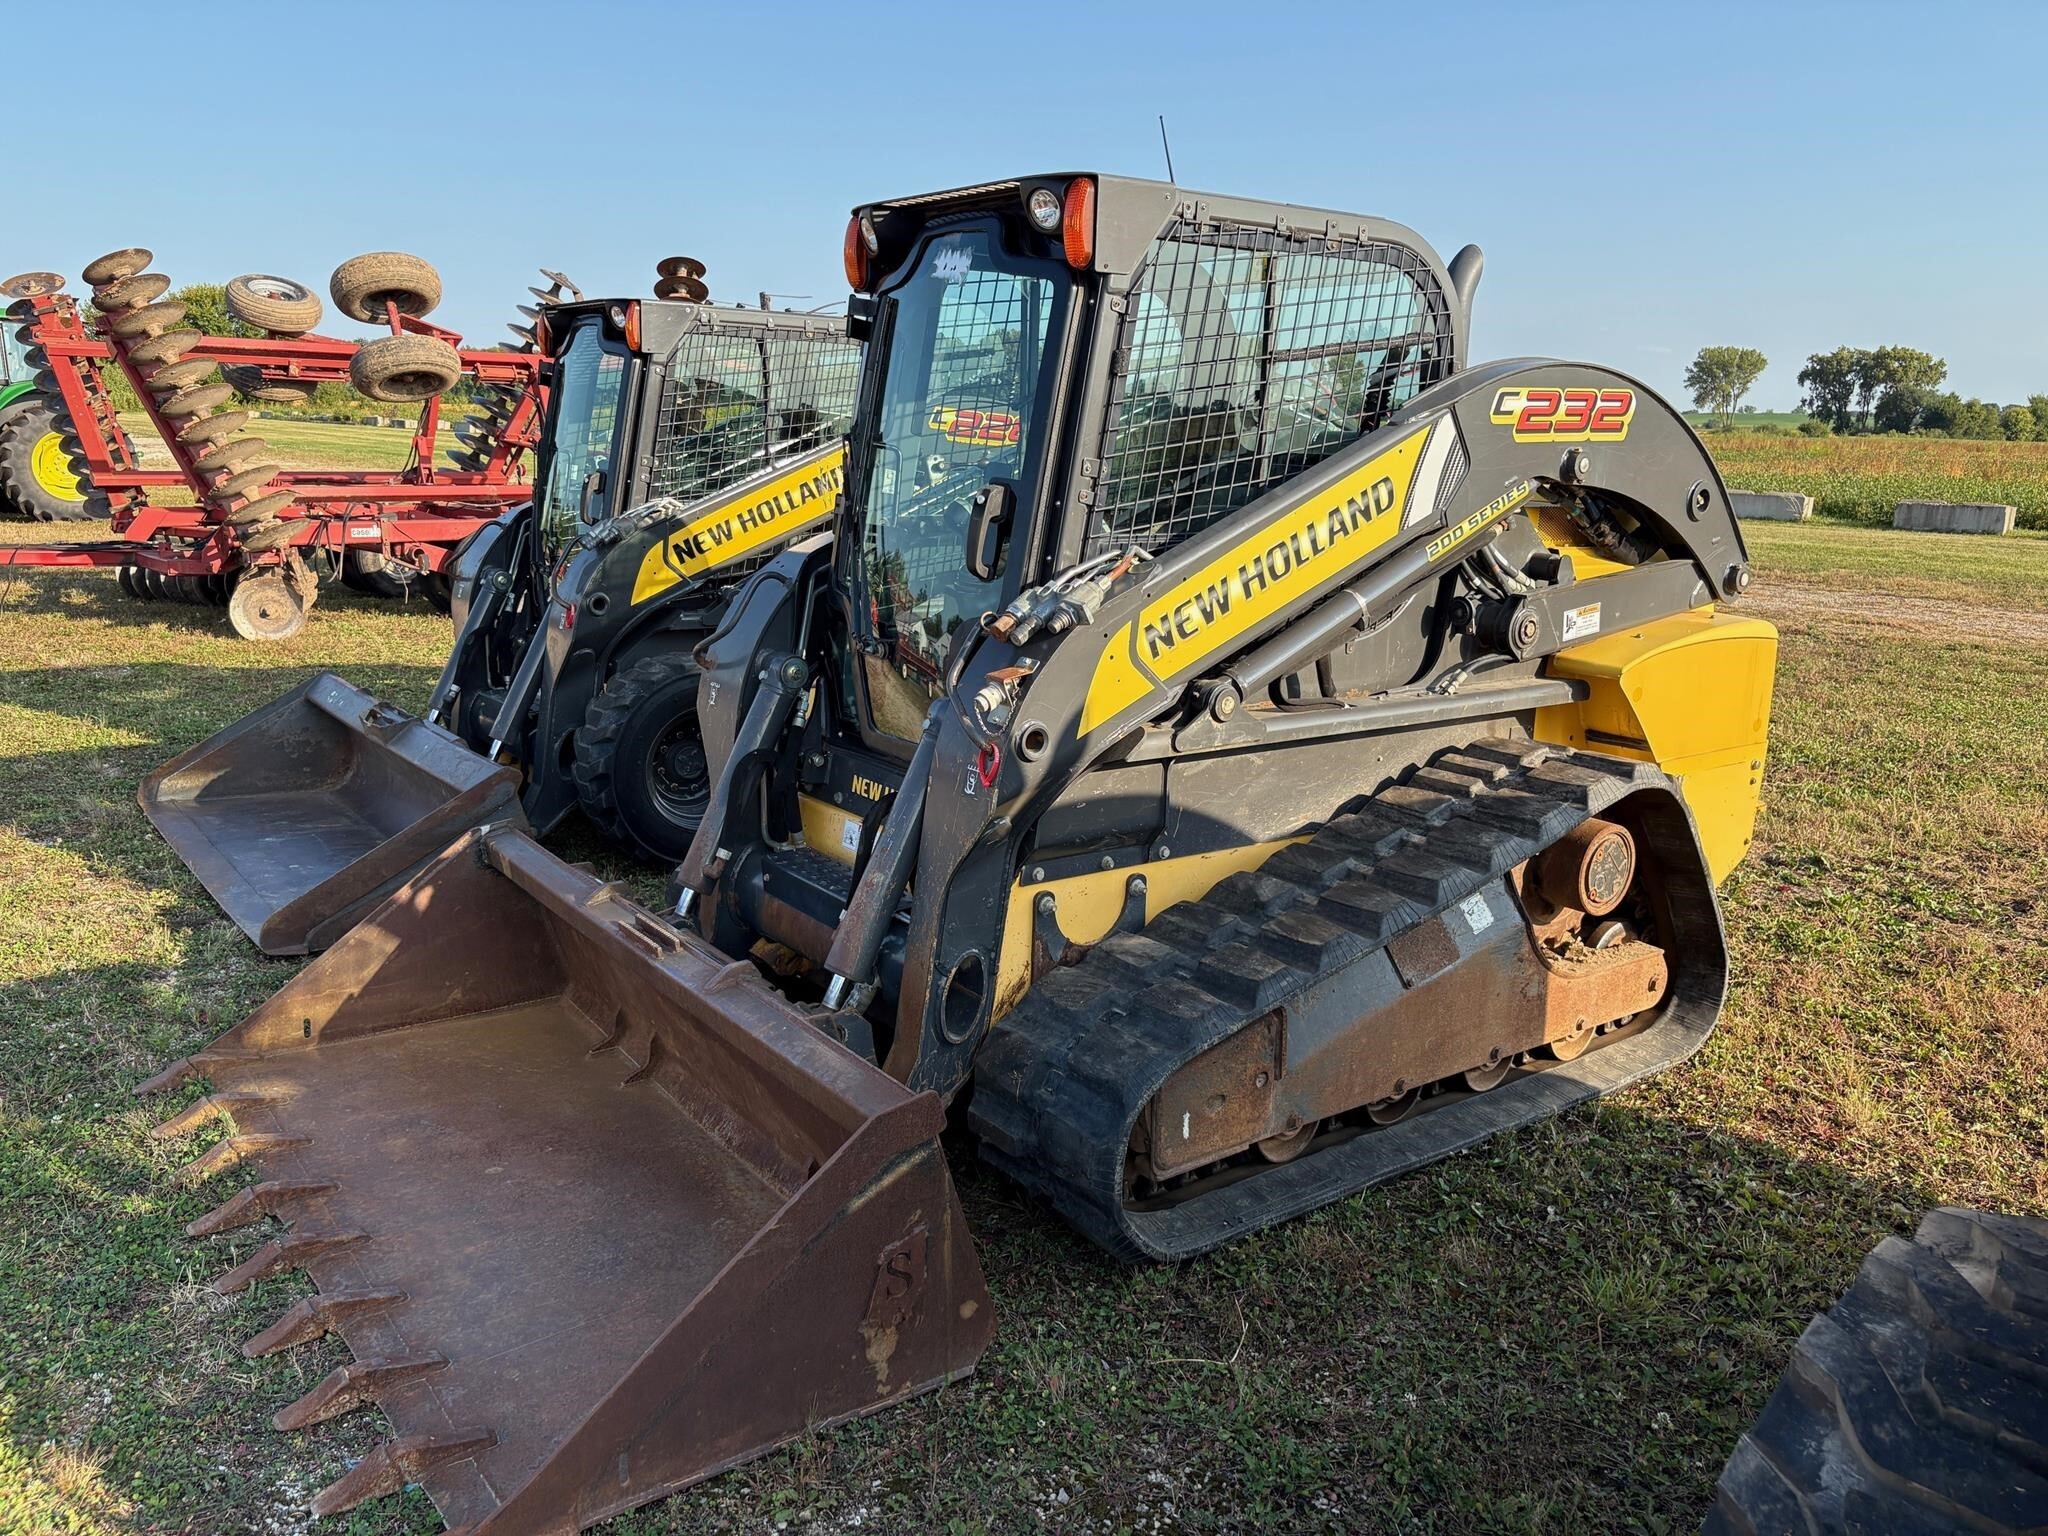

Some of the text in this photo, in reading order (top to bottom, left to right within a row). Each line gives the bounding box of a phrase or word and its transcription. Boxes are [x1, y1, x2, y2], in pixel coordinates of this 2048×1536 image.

[1492, 390, 1633, 434] C232
[671, 518, 734, 566] NEW
[1427, 485, 1528, 559] 200 SERIES
[1143, 475, 1396, 660] NEW HOLLAND
[851, 774, 883, 802] NEW
[886, 1252, 913, 1299] S
